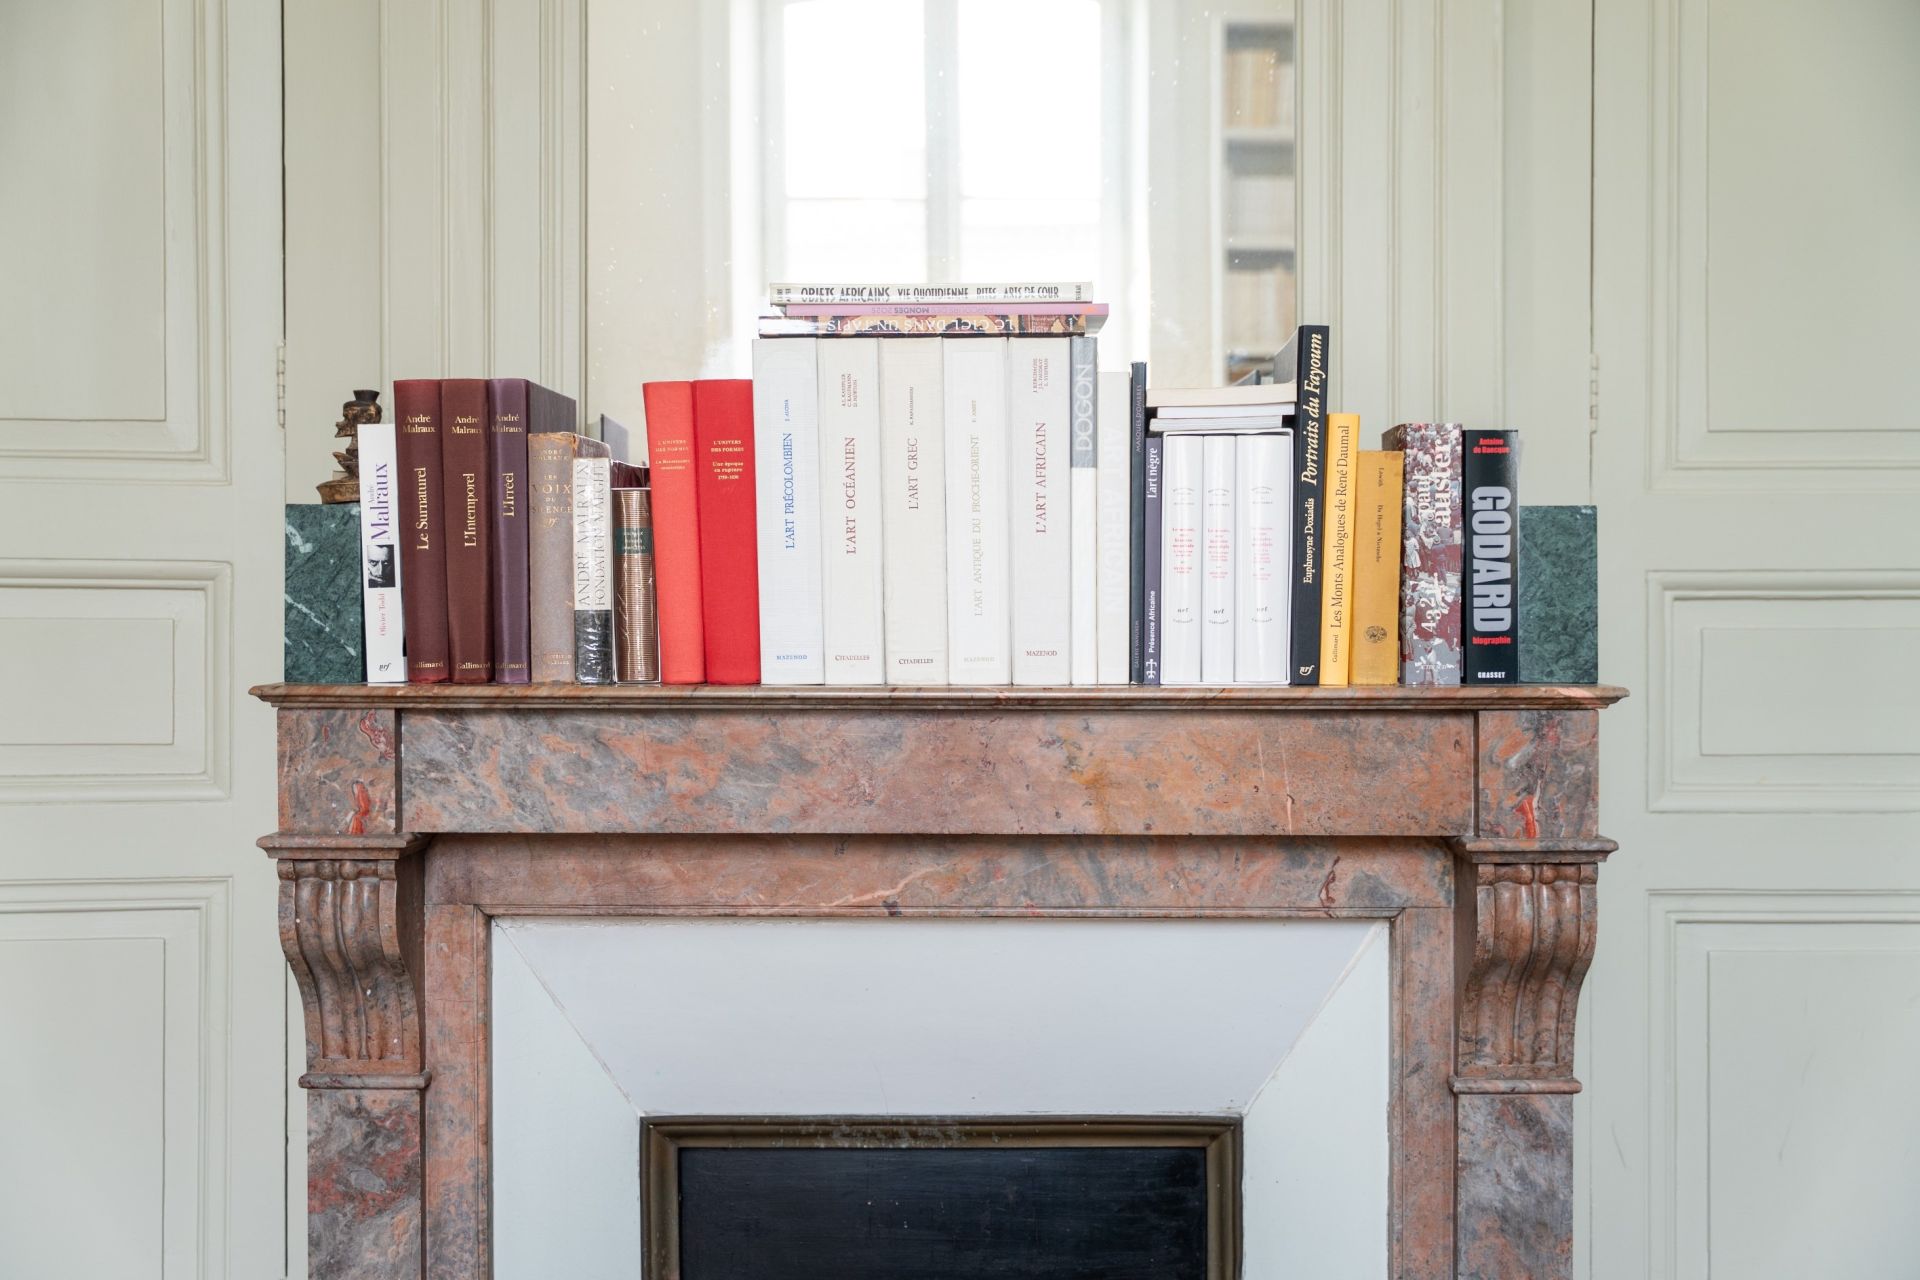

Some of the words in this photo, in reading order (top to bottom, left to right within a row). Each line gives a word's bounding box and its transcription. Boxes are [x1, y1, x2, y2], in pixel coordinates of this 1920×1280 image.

[827, 319, 872, 332] TAPIS
[904, 319, 947, 331] DANS
[1304, 333, 1326, 395] Fayoum
[405, 413, 431, 423] André
[495, 414, 520, 422] André
[1075, 365, 1093, 450] DOGON
[1303, 397, 1320, 418] du
[402, 425, 436, 434] Malraux
[1337, 425, 1350, 467] Daumal
[907, 438, 918, 470] GREC
[1035, 422, 1046, 487] AFRICAIN
[1148, 448, 1159, 476] nègre
[1301, 419, 1318, 487] Portraits
[783, 432, 794, 514] PRÉCOLOMBIEN
[843, 437, 856, 510] OCÉANIEN
[1146, 478, 1158, 498] L'art
[1336, 468, 1348, 498] René
[1430, 438, 1451, 526] auster
[370, 463, 391, 542] Malraux
[414, 467, 428, 530] Surnaturel
[463, 473, 478, 547] L'Intemporel
[502, 472, 515, 518] L'Irréel
[575, 463, 591, 544] MALRAUX
[593, 463, 606, 525] MAEGHT
[908, 476, 919, 510] L'ART
[1335, 499, 1347, 511] de
[1412, 474, 1435, 514] paul
[1036, 493, 1047, 534] L'ART
[1304, 498, 1315, 534] Doxiadis
[417, 533, 429, 550] Le
[785, 519, 795, 549] L'ART
[846, 517, 857, 554] L'ART
[1333, 513, 1349, 570] Analogues
[594, 528, 606, 606] FONDATION
[1303, 535, 1315, 584] Euphrosyne
[1472, 486, 1511, 632] GODARD
[577, 554, 591, 606] ANDRÉ
[1331, 572, 1343, 607] Monts
[378, 593, 387, 611] Todd
[974, 590, 983, 616] L'ART
[1148, 590, 1156, 620] Africaine
[1331, 610, 1343, 628] Les
[1148, 622, 1156, 653] Présence
[1472, 636, 1511, 646] biographie
[378, 662, 391, 672] nrf
[414, 661, 443, 669] allimard
